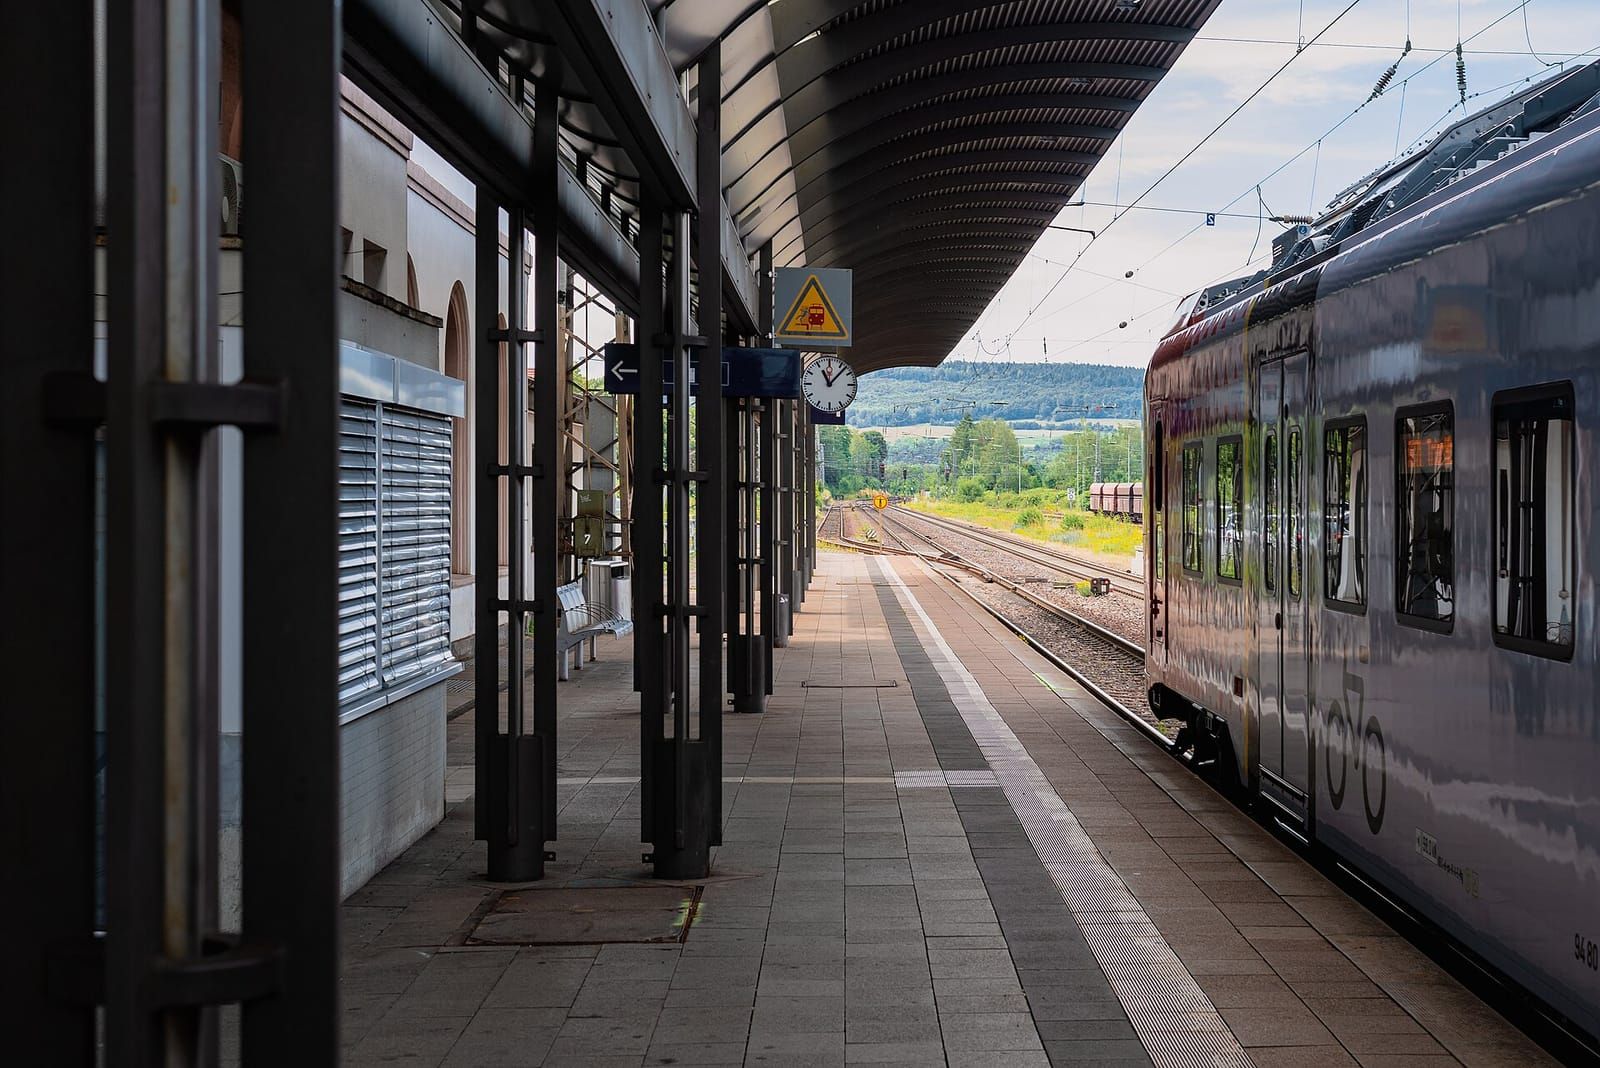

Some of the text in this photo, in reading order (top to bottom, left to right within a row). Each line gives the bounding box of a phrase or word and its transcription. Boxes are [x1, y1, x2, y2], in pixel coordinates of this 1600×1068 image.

[584, 534, 591, 545] 7
[1574, 933, 1599, 972] 94 80
